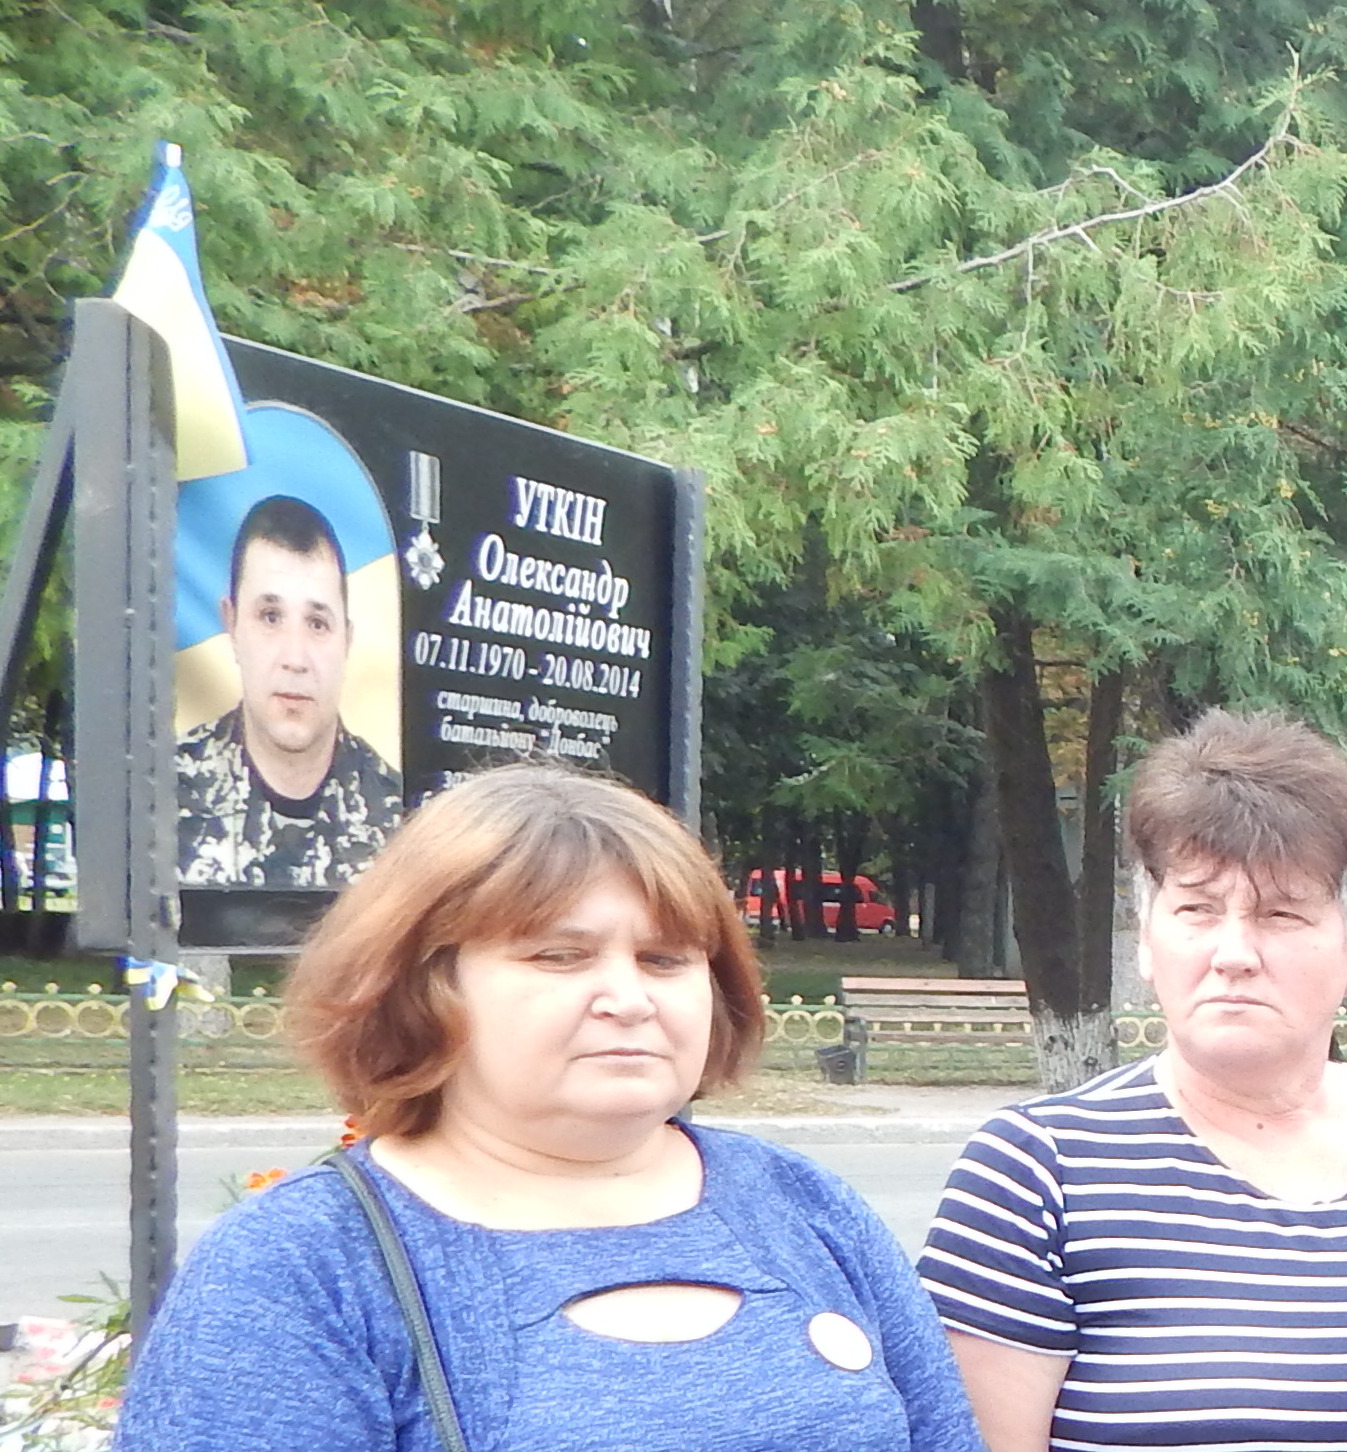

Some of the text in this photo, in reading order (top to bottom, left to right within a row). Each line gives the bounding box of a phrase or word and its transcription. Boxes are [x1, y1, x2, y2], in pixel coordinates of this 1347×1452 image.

[515, 475, 608, 547] УТКІН
[479, 533, 630, 620] Олександр
[449, 578, 651, 659] Анатолійович
[415, 631, 526, 681] 07.11.1970
[541, 653, 642, 699] 20.08.2014
